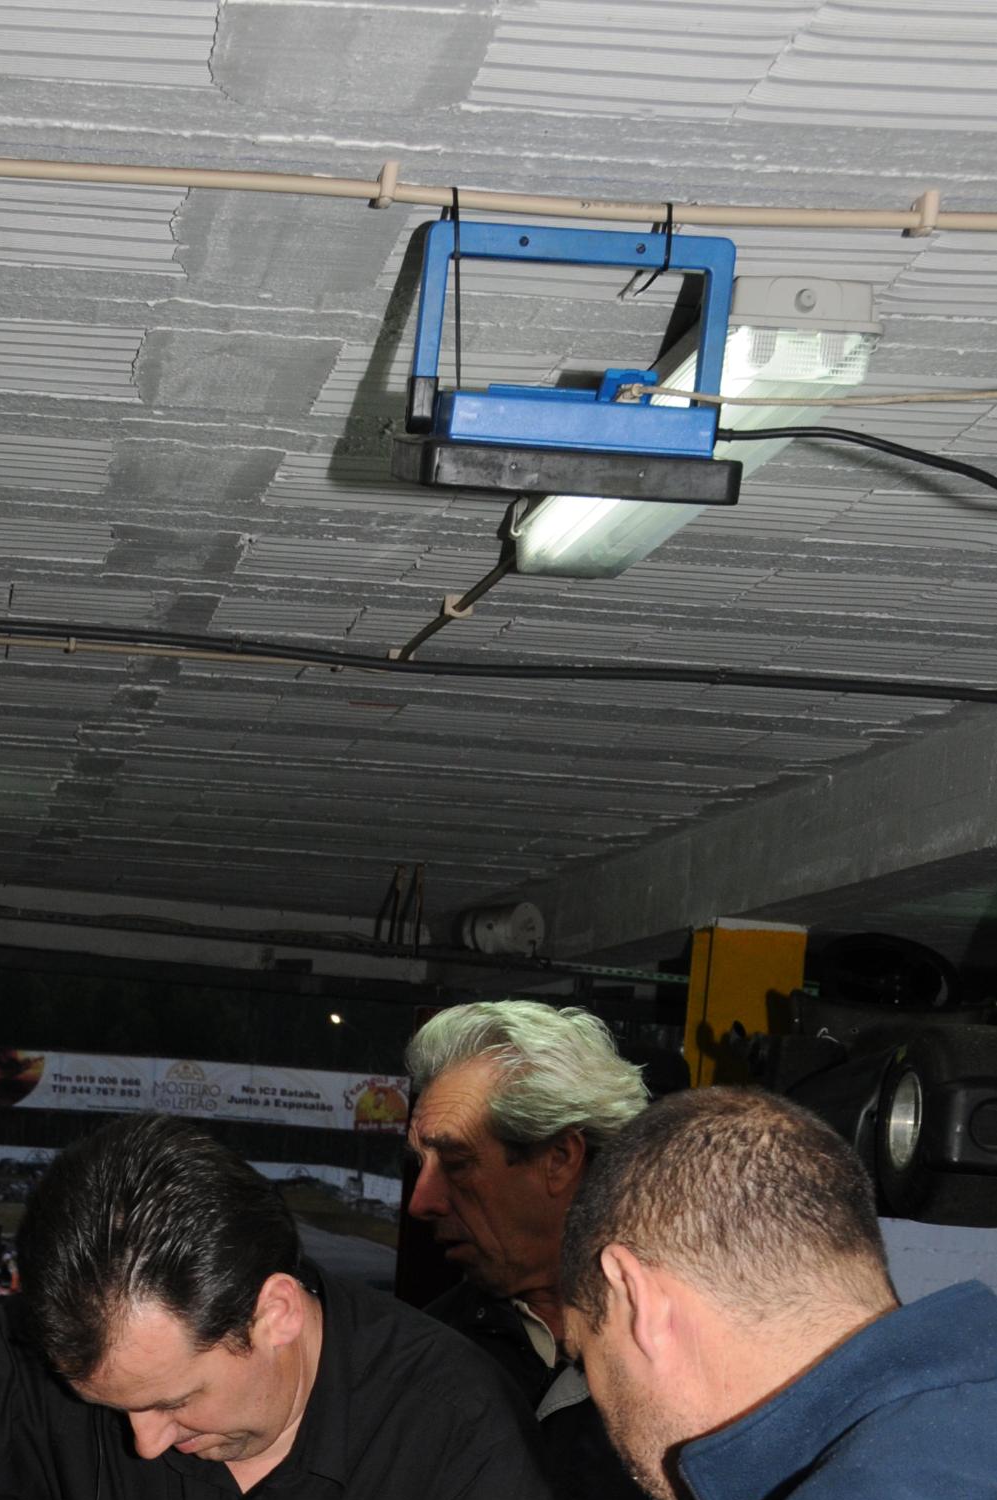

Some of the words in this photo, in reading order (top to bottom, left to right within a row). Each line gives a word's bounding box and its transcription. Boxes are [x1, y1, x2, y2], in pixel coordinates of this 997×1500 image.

[152, 1081, 221, 1097] MOSTEIRO
[280, 1088, 321, 1100] Batalha
[227, 1095, 261, 1106] Junto
